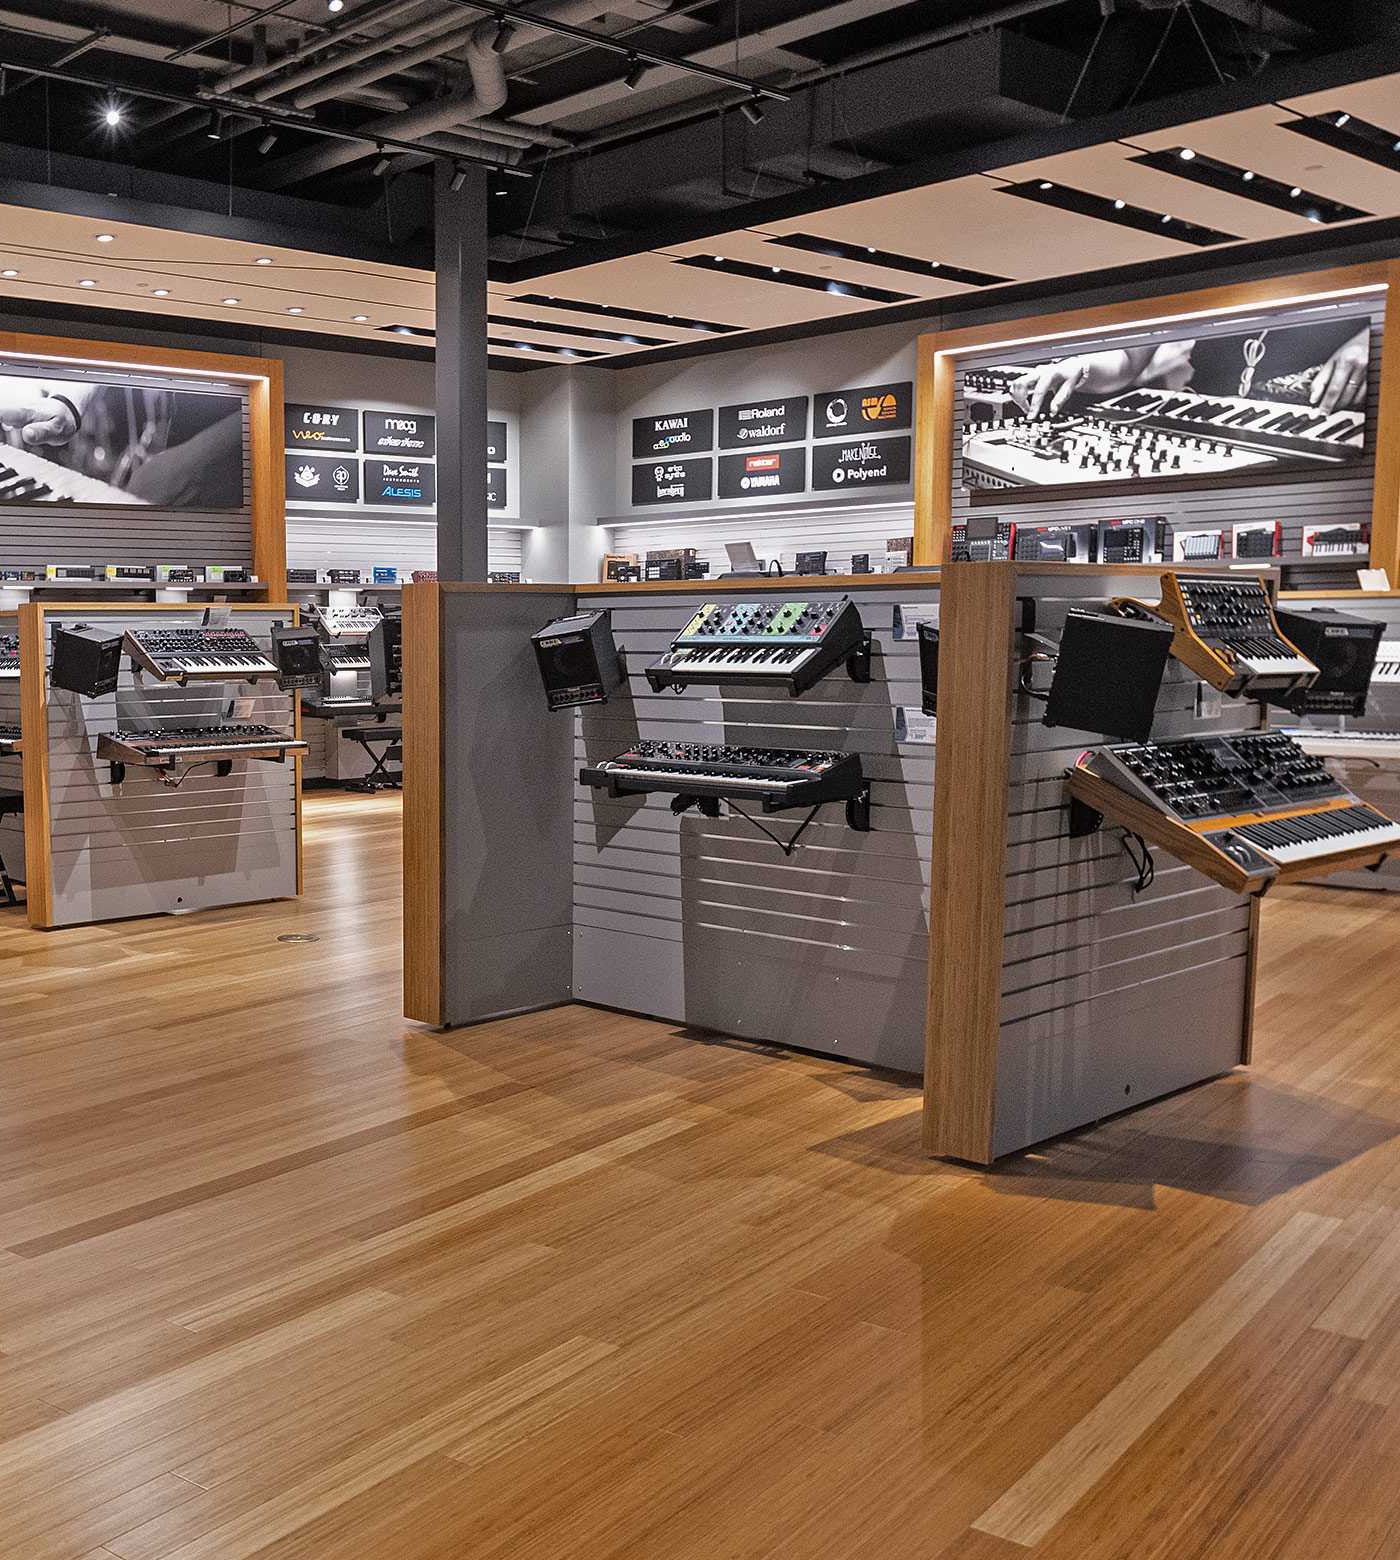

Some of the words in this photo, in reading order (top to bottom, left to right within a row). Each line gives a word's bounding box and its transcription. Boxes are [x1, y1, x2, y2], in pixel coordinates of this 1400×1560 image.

[751, 405, 785, 419] Roland
[385, 418, 417, 434] moog
[654, 417, 689, 432] KAWAI
[748, 422, 786, 438] waldorf
[847, 465, 887, 481] Polyend
[381, 486, 422, 498] ALESIS
